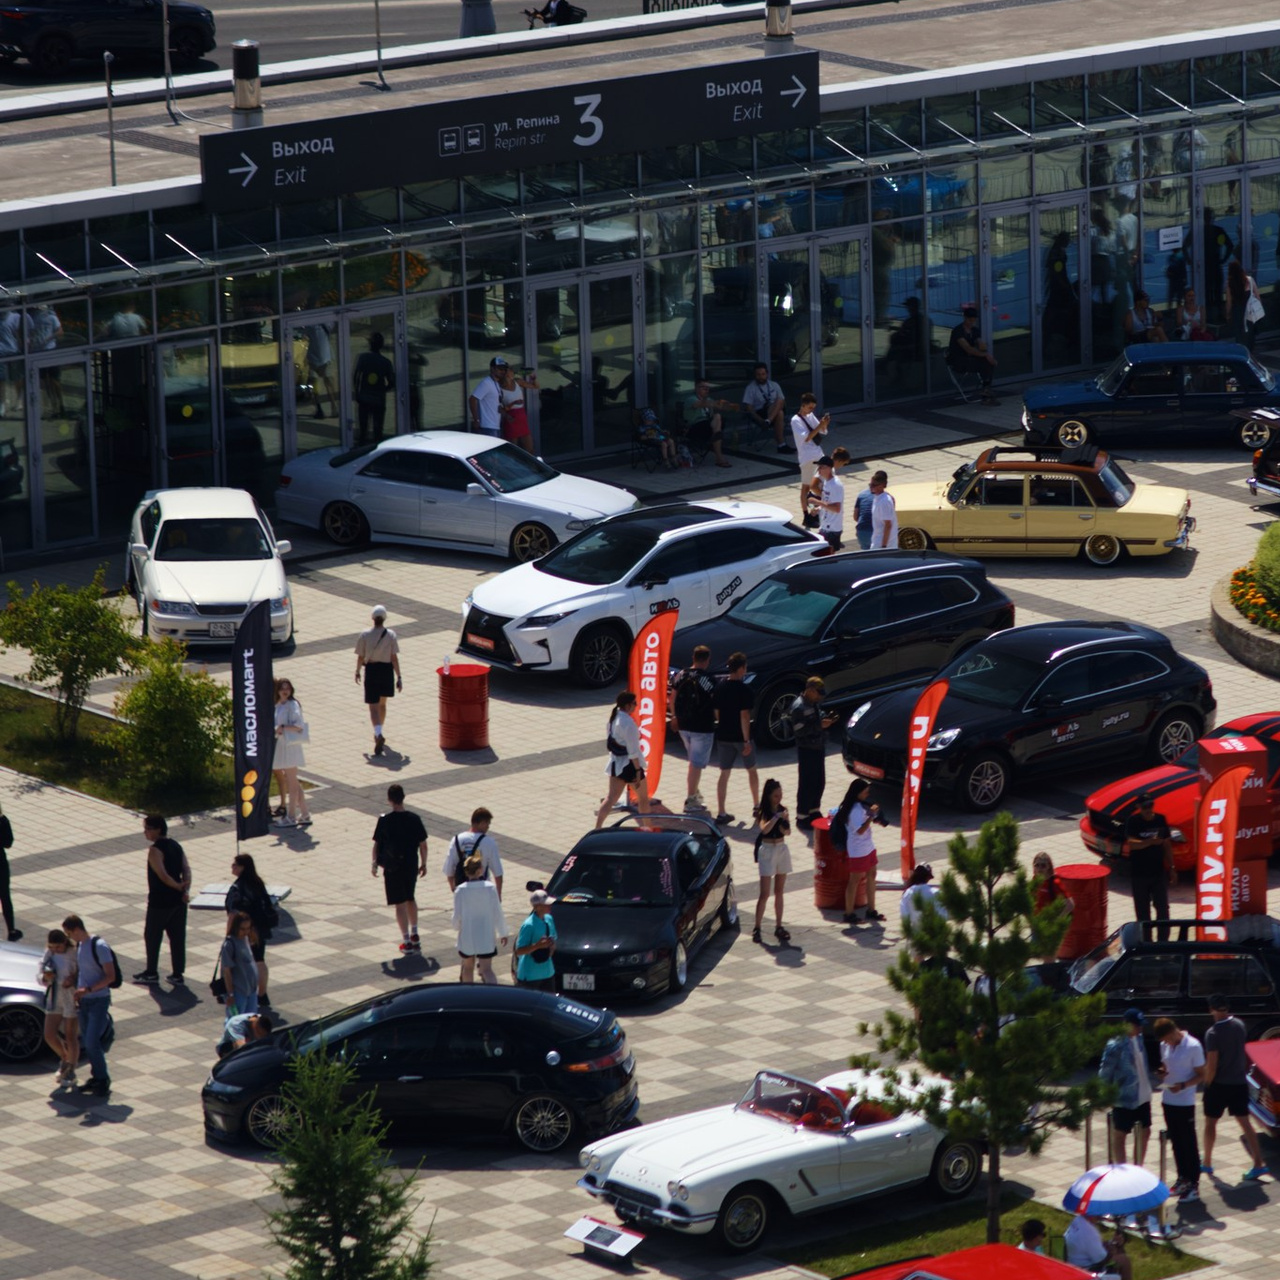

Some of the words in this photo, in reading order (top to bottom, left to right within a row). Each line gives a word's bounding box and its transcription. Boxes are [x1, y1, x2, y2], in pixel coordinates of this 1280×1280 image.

[706, 78, 763, 99] Выход
[572, 93, 604, 147] 3
[733, 103, 763, 122] Exit
[493, 121, 512, 134] ул.
[516, 114, 560, 130] Репина
[272, 137, 335, 159] Выход
[495, 135, 527, 151] Repin
[529, 131, 548, 145] str.
[274, 165, 307, 186] Exit
[717, 577, 741, 604] july.ru
[1102, 711, 1129, 729] july.ru
[1235, 825, 1269, 840] uly.ru
[1199, 798, 1228, 941] july.ru
